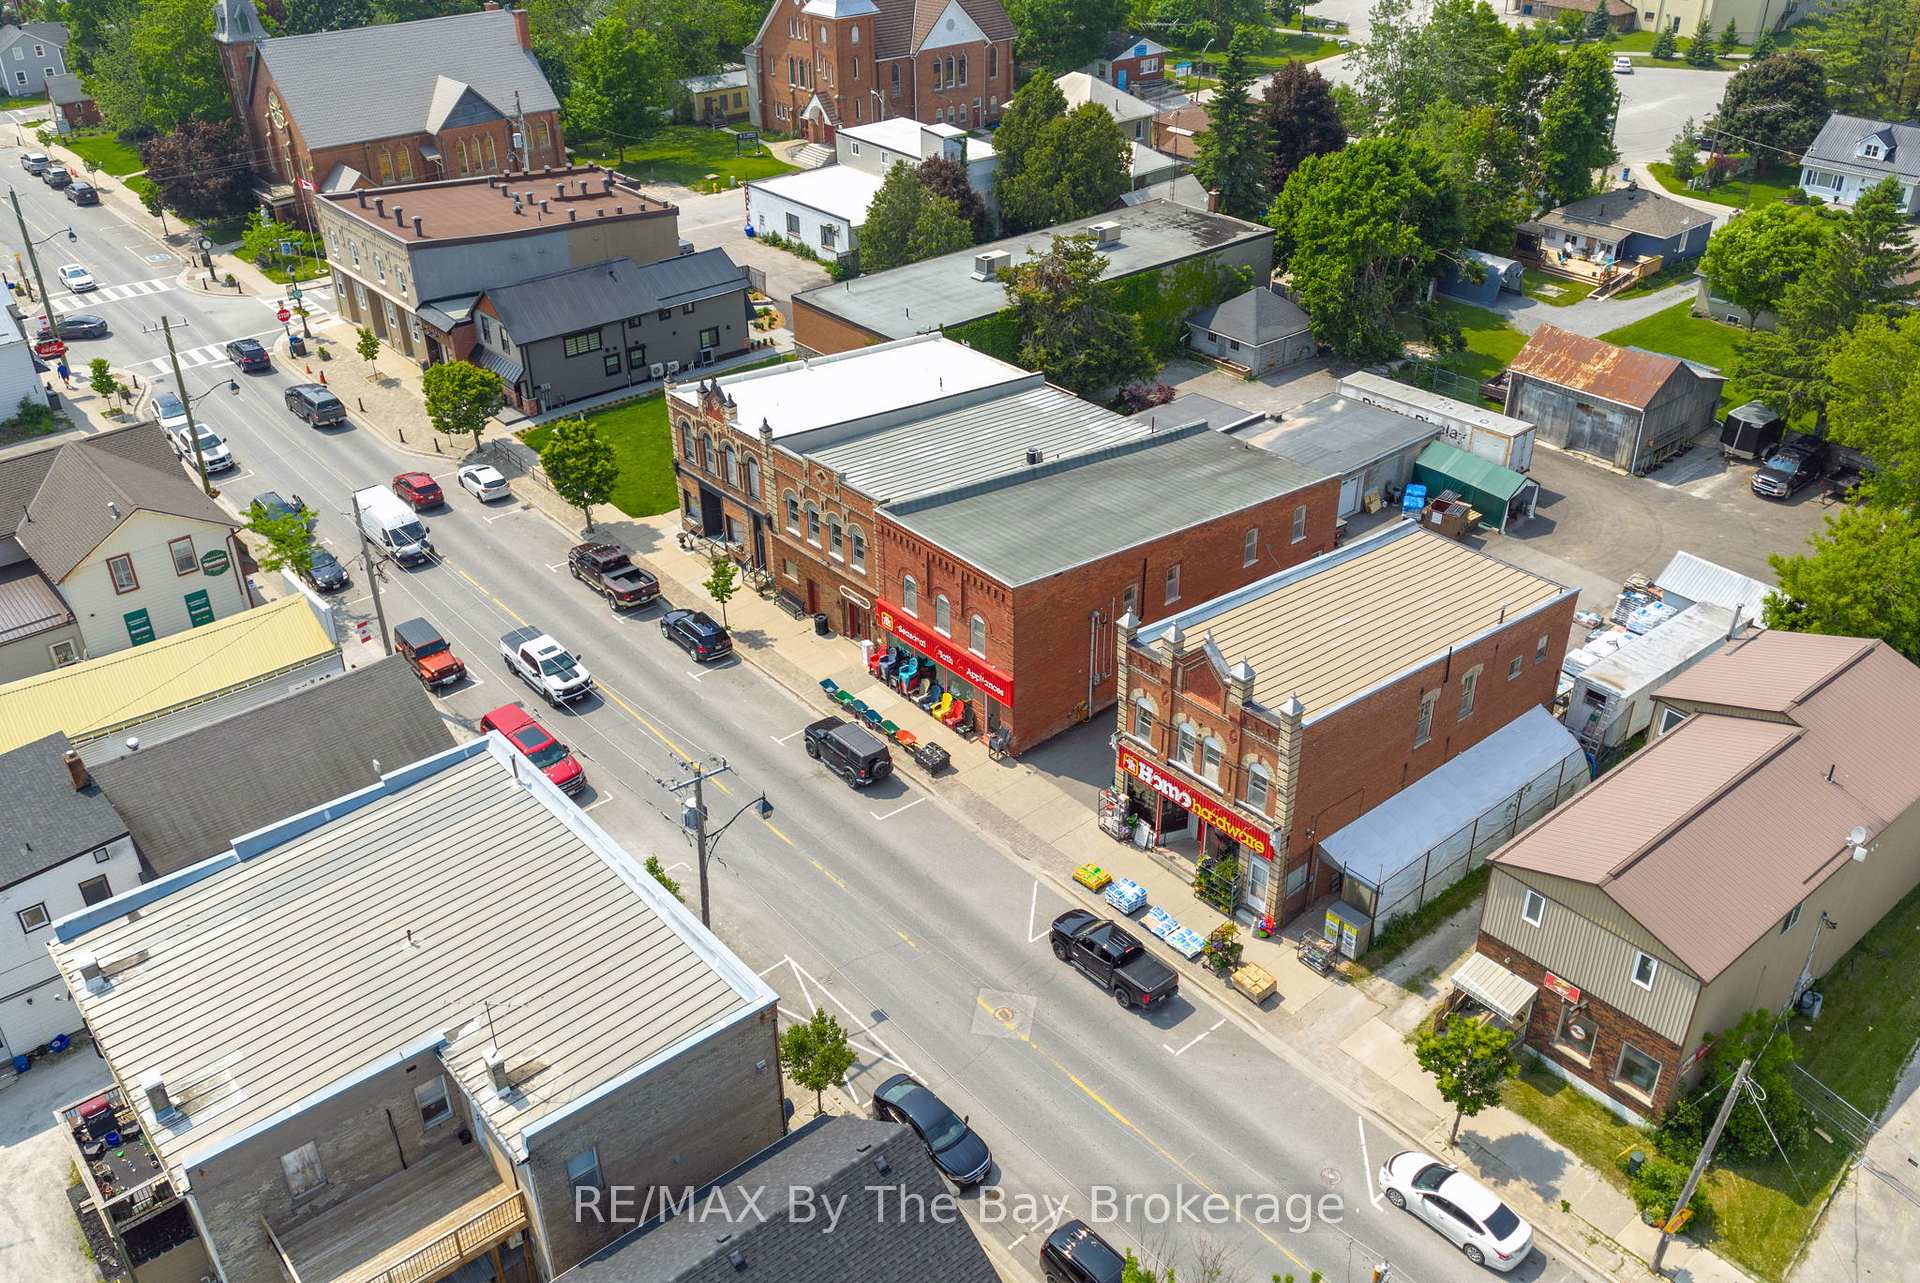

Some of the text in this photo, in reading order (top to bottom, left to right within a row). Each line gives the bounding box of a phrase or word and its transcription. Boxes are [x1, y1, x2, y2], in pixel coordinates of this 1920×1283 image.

[966, 667, 1005, 697] Appliances
[1138, 761, 1265, 854] Home hardware
